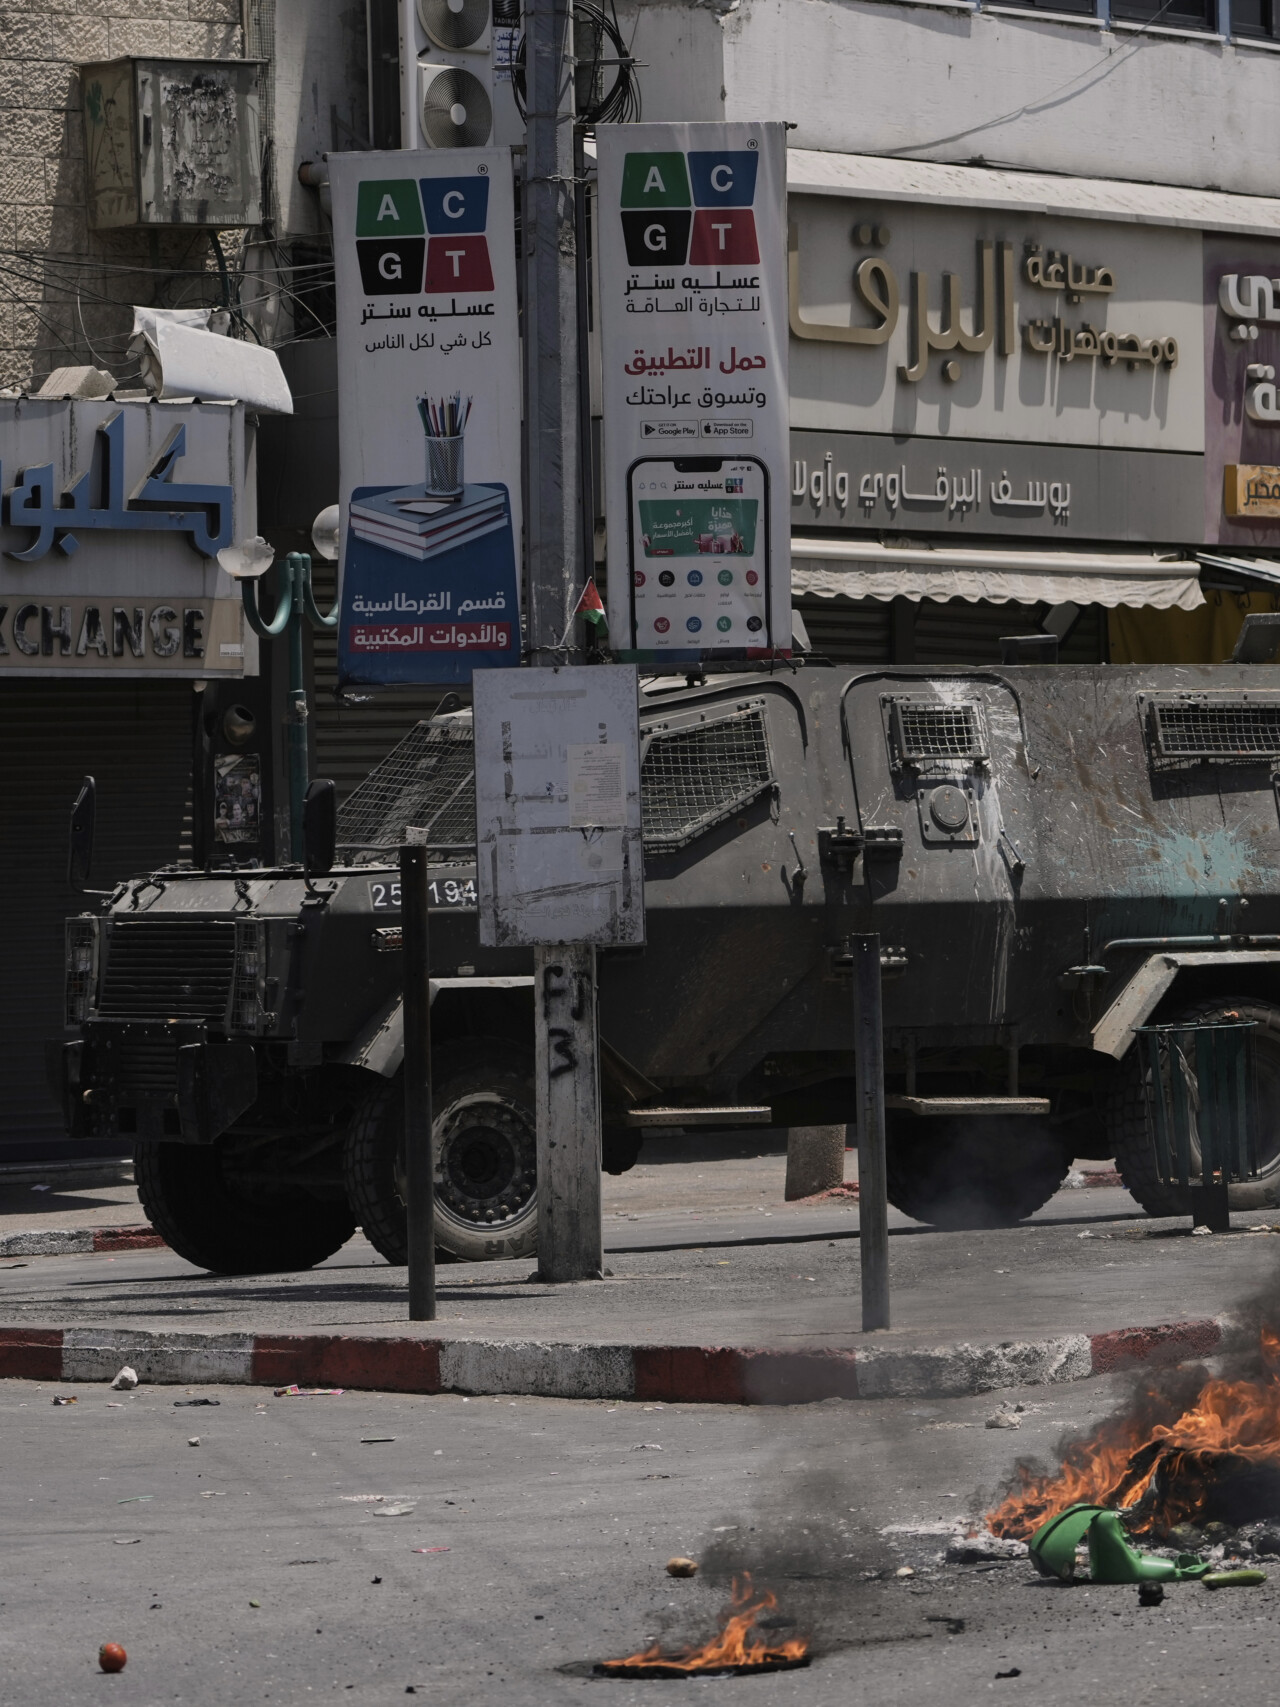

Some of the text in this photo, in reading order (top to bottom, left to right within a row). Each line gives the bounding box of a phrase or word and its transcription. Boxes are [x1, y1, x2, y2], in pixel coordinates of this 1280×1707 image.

[624, 271, 760, 296] عسليه سنتر
[1025, 244, 1117, 303] صياغة
[360, 299, 495, 325] عسليه سنتر
[698, 296, 760, 317] للتجارة
[365, 331, 492, 355] كل شي لكل الناس
[1022, 317, 1179, 369] ومجوهرات
[624, 347, 766, 376] حمل التطبيق
[625, 385, 767, 408] وتسوق عراحتك
[658, 427, 696, 436] Google Play
[713, 427, 729, 436] App
[673, 480, 695, 492] سنتر
[859, 465, 982, 511] البرقاوي
[990, 470, 1071, 517] يوسف
[351, 591, 506, 617] قسم القرطاسية
[354, 624, 508, 650] والأدوات المكتبية
